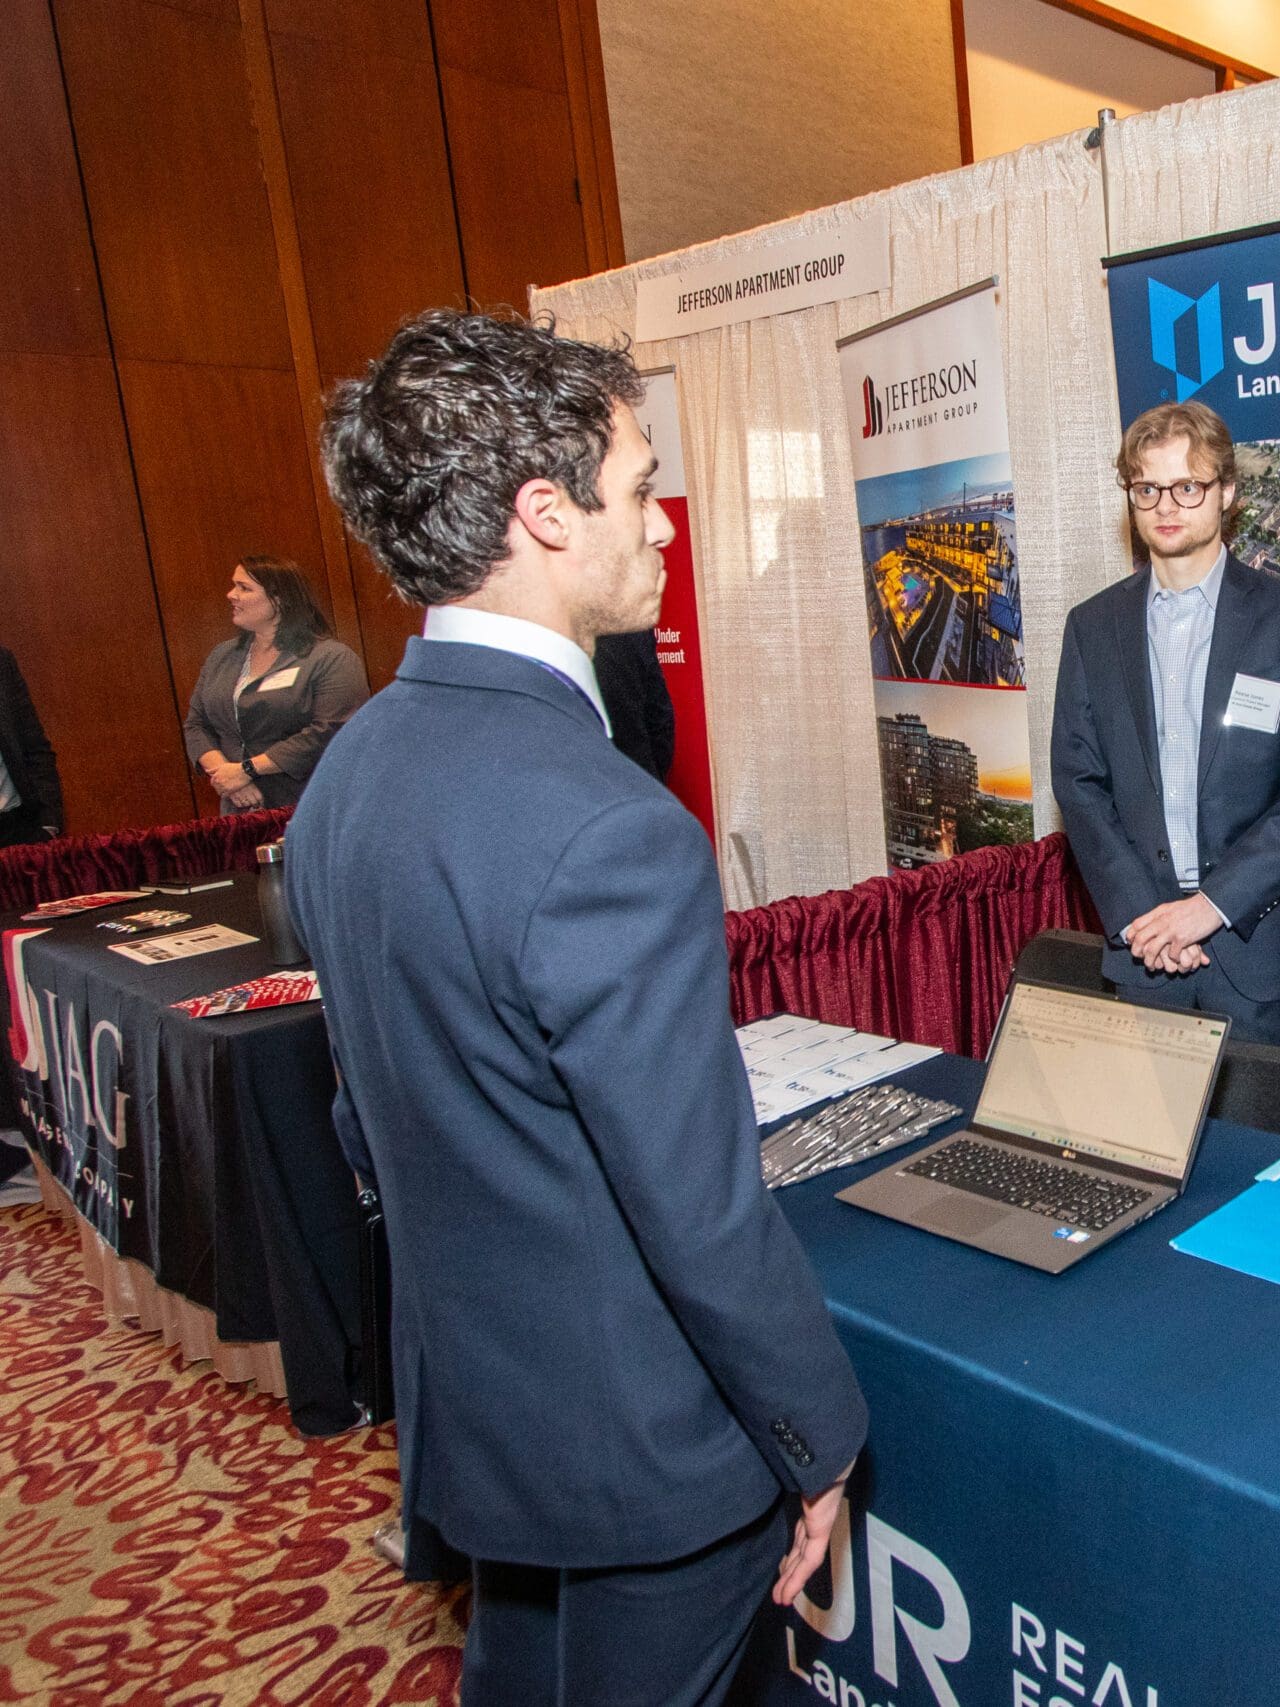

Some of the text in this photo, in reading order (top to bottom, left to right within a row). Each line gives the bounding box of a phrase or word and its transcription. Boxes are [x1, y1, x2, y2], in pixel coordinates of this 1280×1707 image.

[677, 253, 845, 314] JEFFERSON APARTMENT GROUP
[885, 359, 977, 421] JEFFERSON
[887, 402, 978, 435] APARTMENT GROUP
[786, 1625, 898, 1707] Lan
